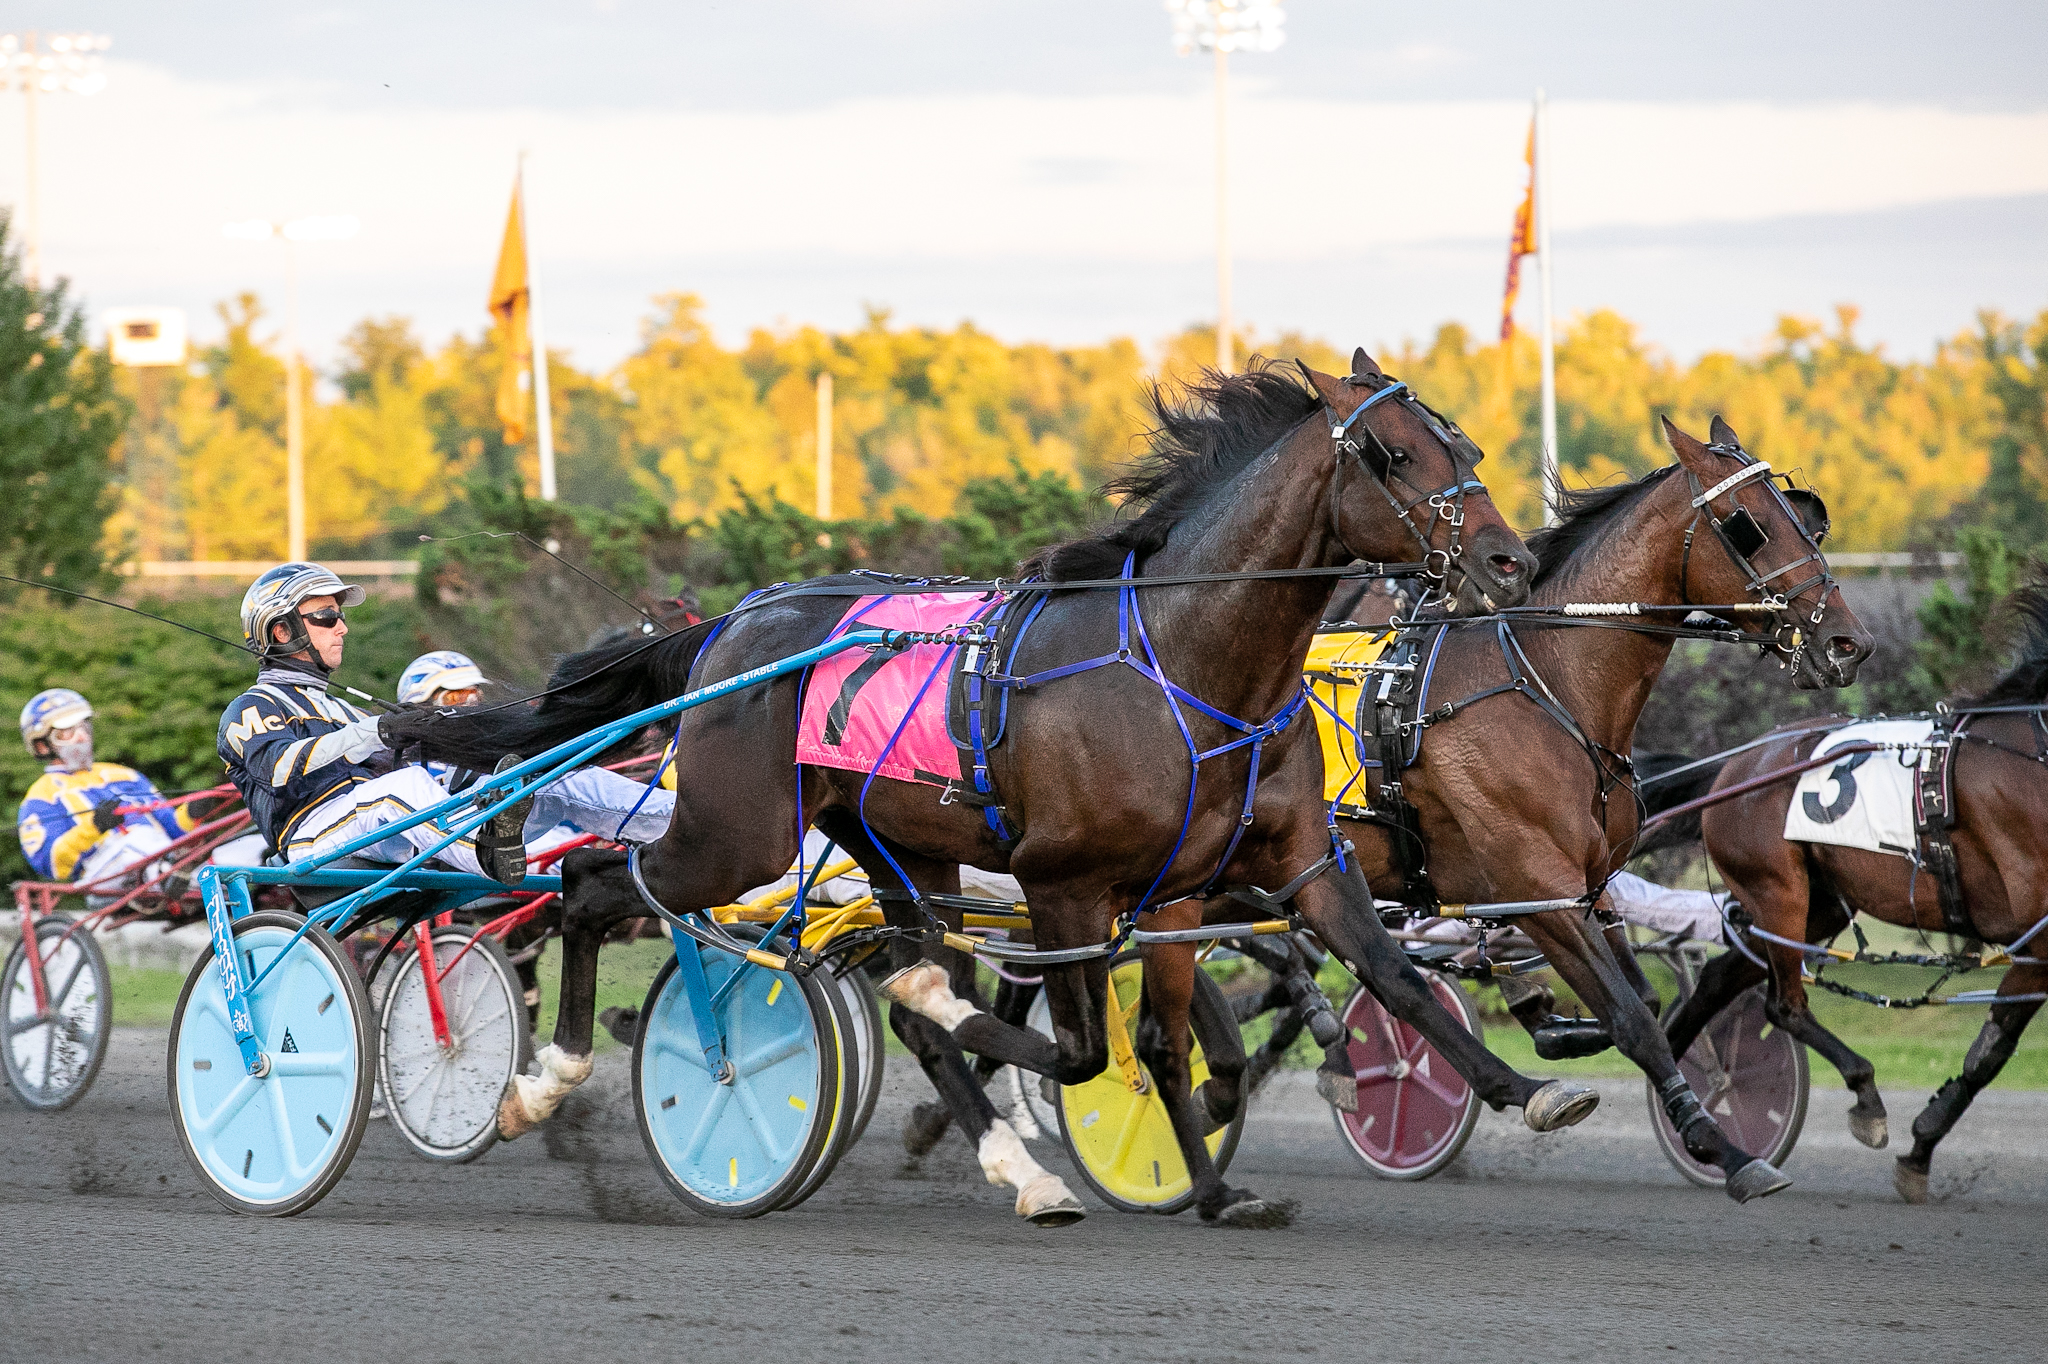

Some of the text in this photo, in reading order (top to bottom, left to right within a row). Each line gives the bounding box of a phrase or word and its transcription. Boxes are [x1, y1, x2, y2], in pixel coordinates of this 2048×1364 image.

[663, 662, 779, 710] DR. IAN MOORE STABLE
[821, 620, 918, 747] 7
[225, 706, 285, 759] Mc
[1802, 739, 1872, 824] 3
